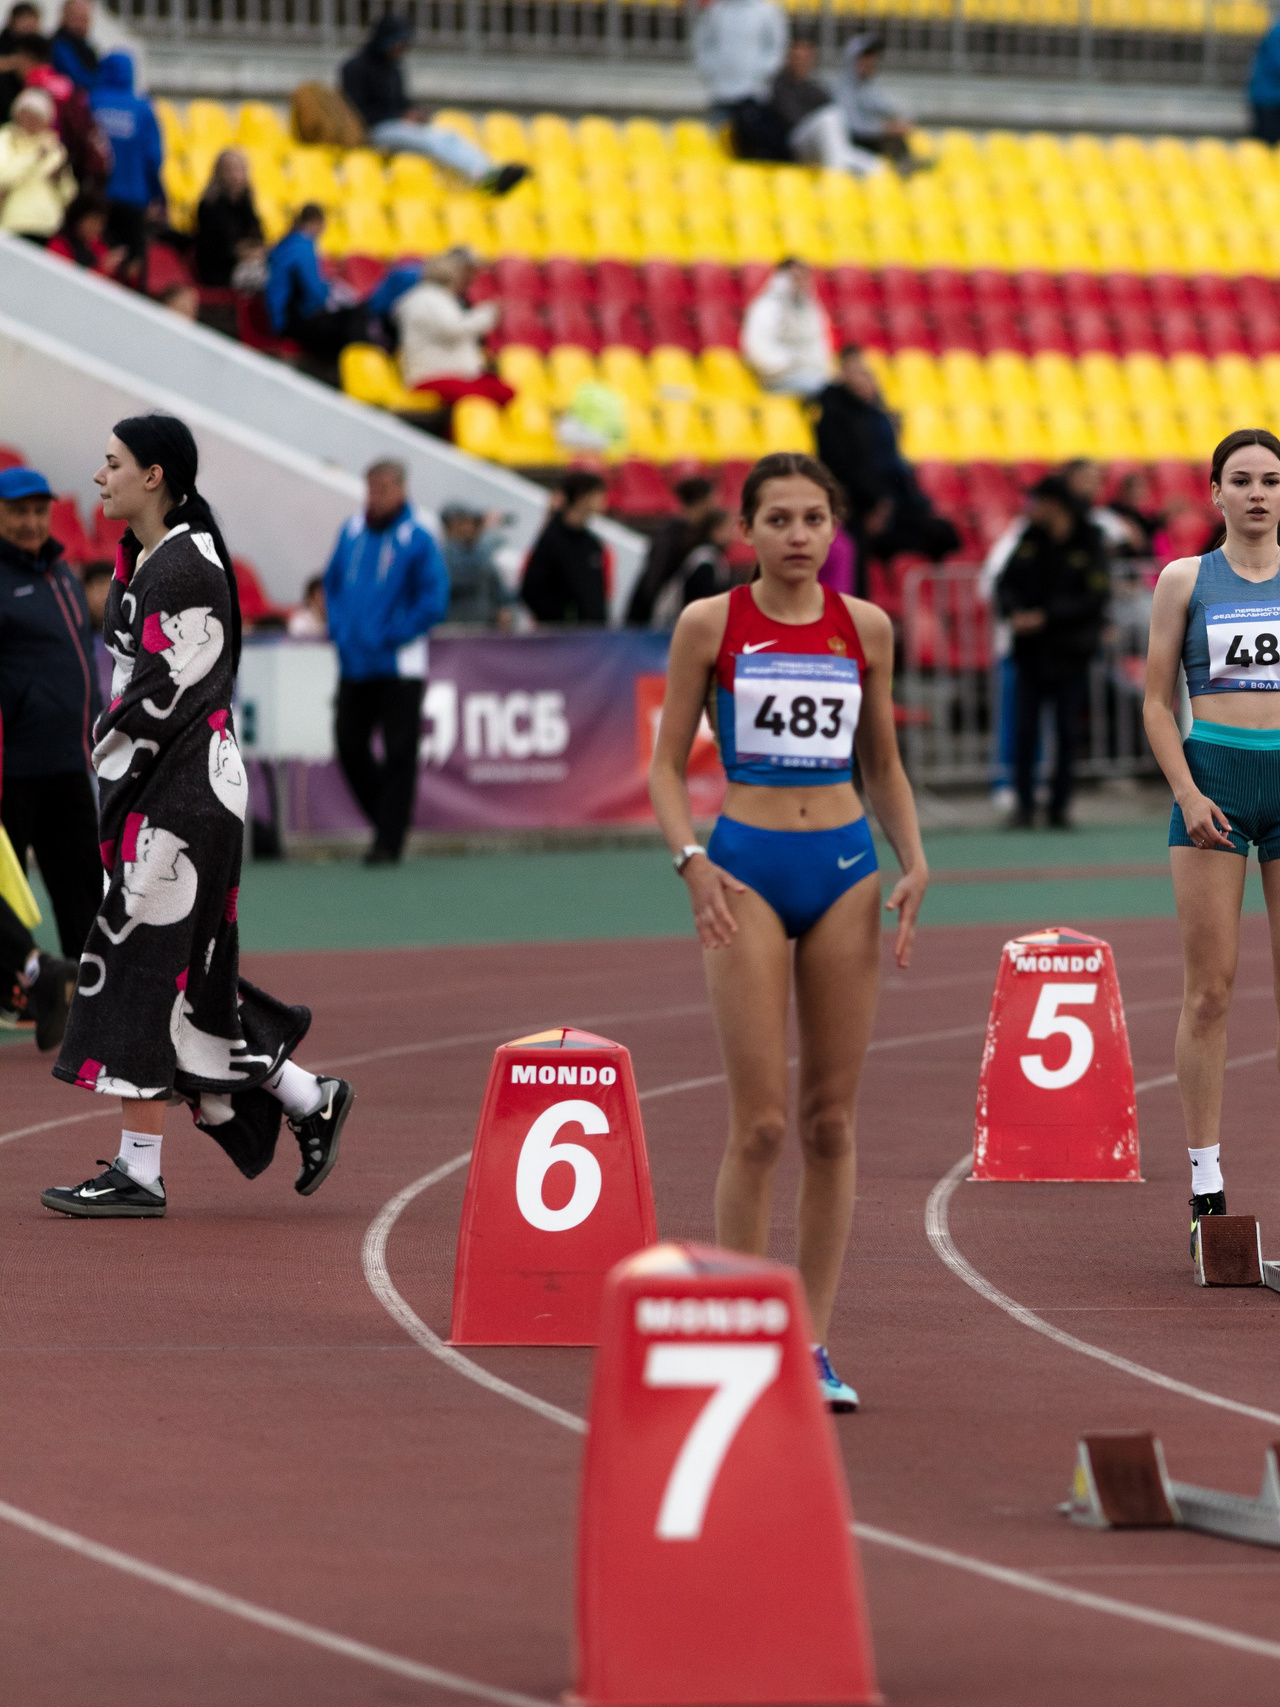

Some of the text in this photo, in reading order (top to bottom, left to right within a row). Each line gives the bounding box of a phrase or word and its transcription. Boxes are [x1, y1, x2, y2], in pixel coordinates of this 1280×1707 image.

[1212, 611, 1278, 620] ФЕДЕРАЛЬНОГО
[464, 691, 570, 761] ПСБ
[754, 695, 844, 739] 483
[1016, 956, 1099, 972] MONDO
[1019, 983, 1098, 1090] 5
[511, 1065, 617, 1085] MONDO
[516, 1099, 610, 1232] 6
[636, 1298, 789, 1335] MONDO
[643, 1341, 783, 1541] 7
